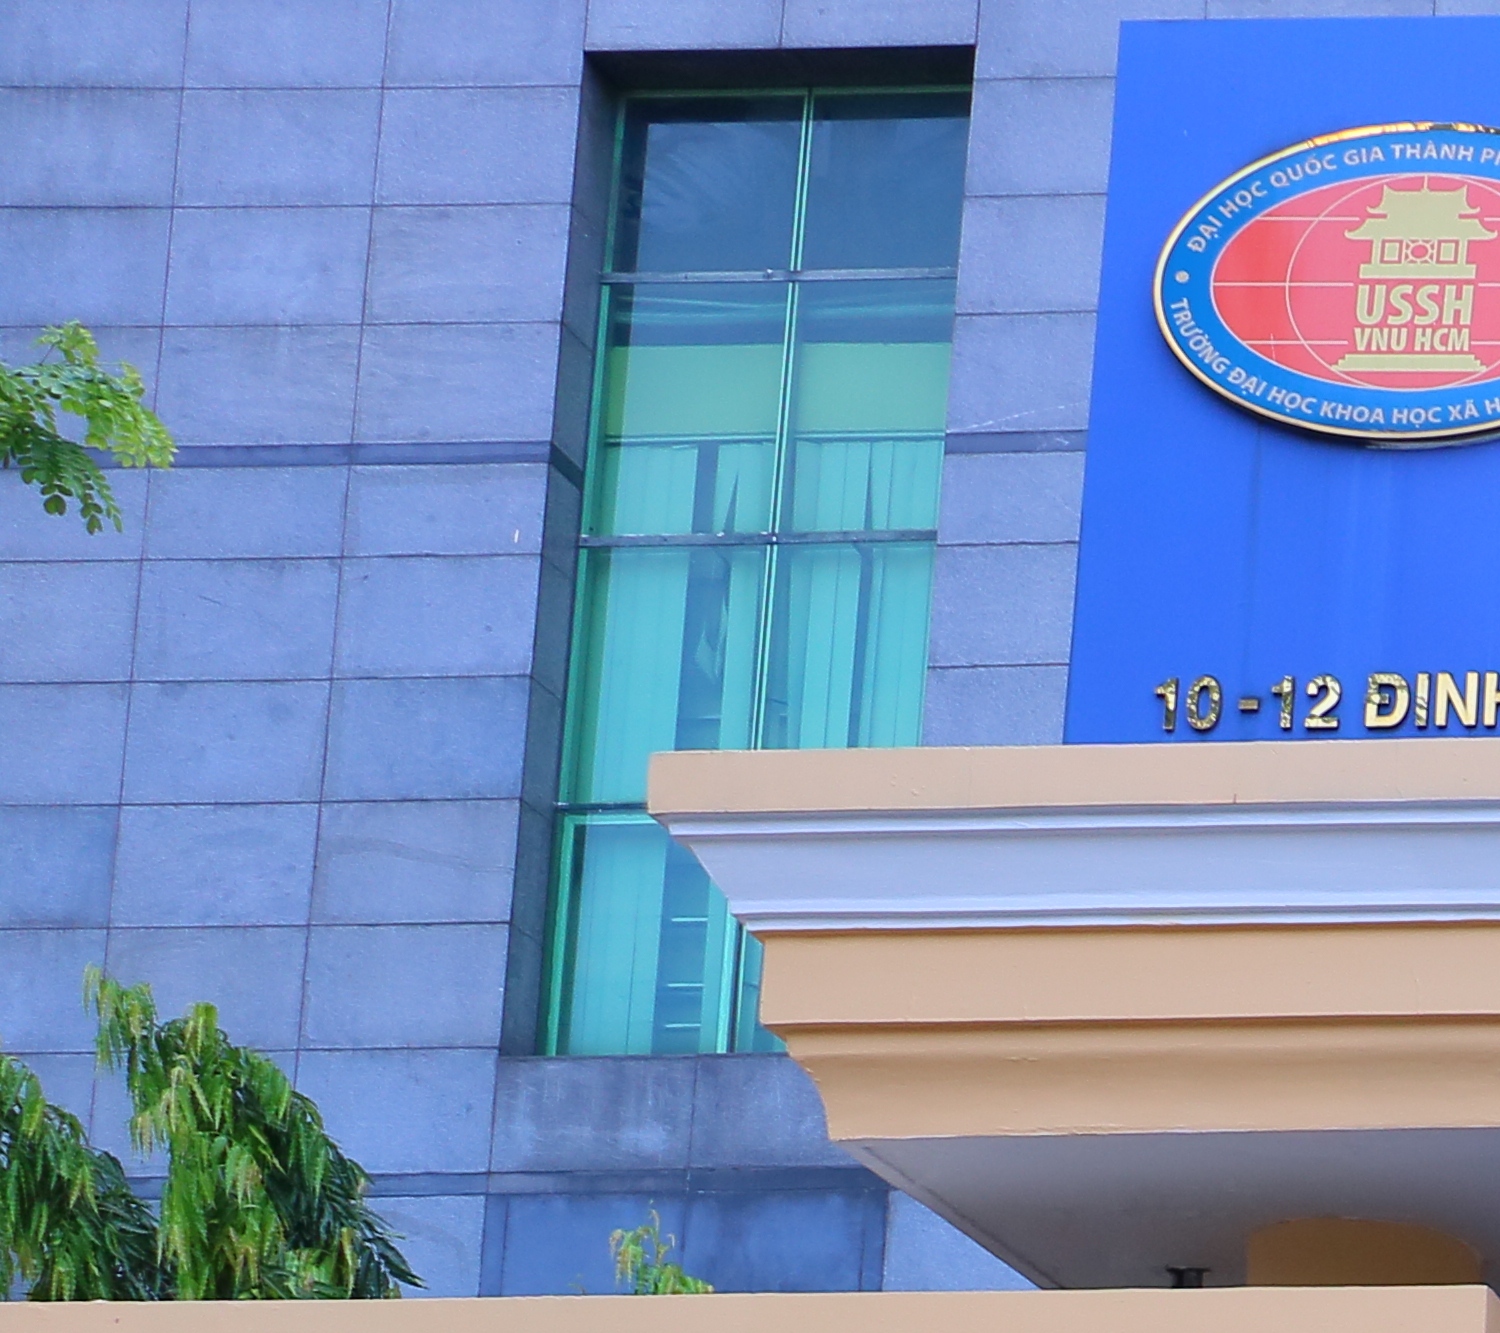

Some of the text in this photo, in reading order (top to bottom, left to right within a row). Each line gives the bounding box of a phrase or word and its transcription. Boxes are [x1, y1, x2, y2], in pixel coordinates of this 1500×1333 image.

[1188, 217, 1222, 254] ĐẠI
[1223, 182, 1269, 221] HỌC
[1270, 152, 1337, 189] QUỐC
[1343, 144, 1386, 166] GIA
[1391, 141, 1474, 162] THÀNH
[1354, 328, 1470, 351] VNU HCM
[1355, 284, 1474, 326] USSH
[1169, 298, 1229, 376] TRƯỜNG
[1227, 364, 1266, 398] ĐẠI
[1266, 387, 1317, 416] HỌC
[1320, 401, 1386, 424] KHOA
[1392, 406, 1442, 428] HỌC
[1448, 399, 1479, 423] XÃ
